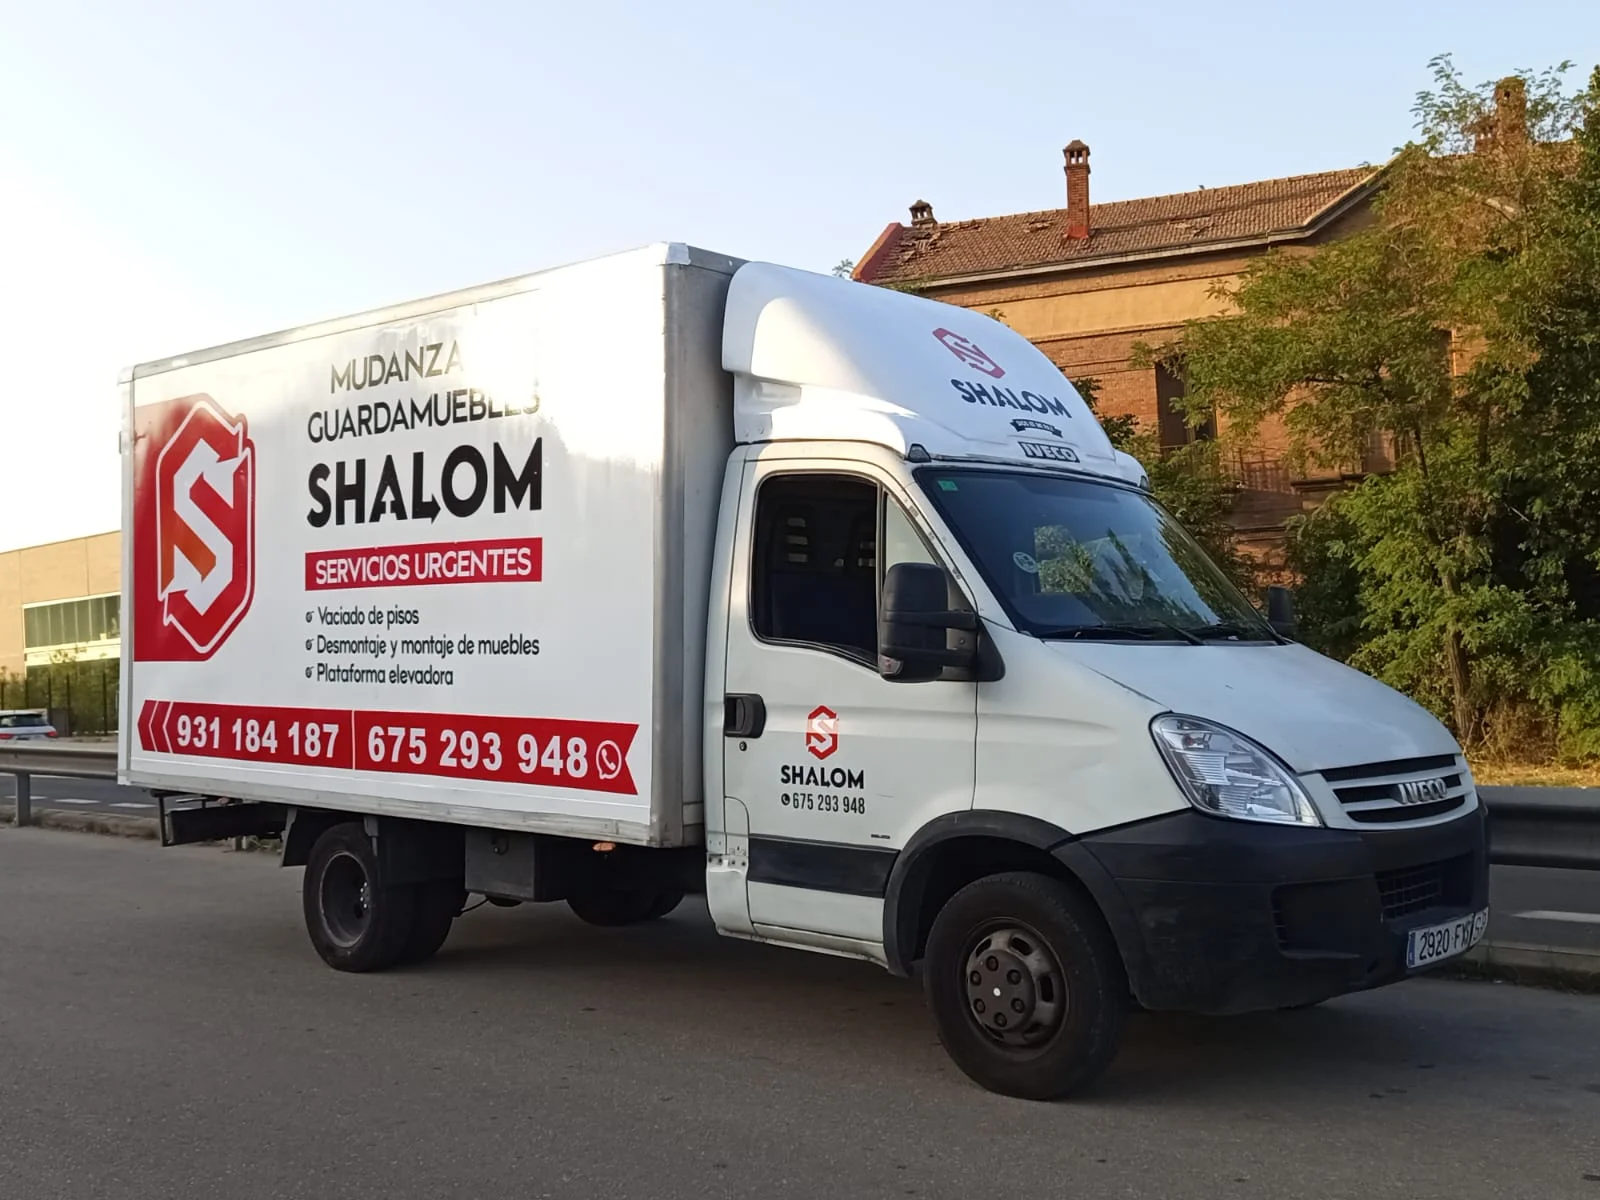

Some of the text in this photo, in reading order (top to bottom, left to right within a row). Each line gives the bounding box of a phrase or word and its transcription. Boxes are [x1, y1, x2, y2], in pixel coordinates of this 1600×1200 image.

[330, 340, 464, 394] MUDANZA
[950, 379, 1072, 418] SHALOM
[1020, 442, 1079, 462] IVECO
[306, 436, 543, 528] SHALOM
[315, 548, 532, 585] SERVICIOS URGENTES
[318, 605, 420, 630] Vaciado de pisos
[317, 633, 540, 659] Desmontaje y montaje de muebles
[317, 663, 454, 685] Plataforma elevadora
[177, 714, 339, 758] 931 184 187
[368, 725, 589, 779] 675 293 948
[781, 764, 864, 789] SHALOM
[792, 792, 866, 814] 675 293 948
[1398, 778, 1448, 805] IVECO
[1419, 928, 1450, 960] 2920
